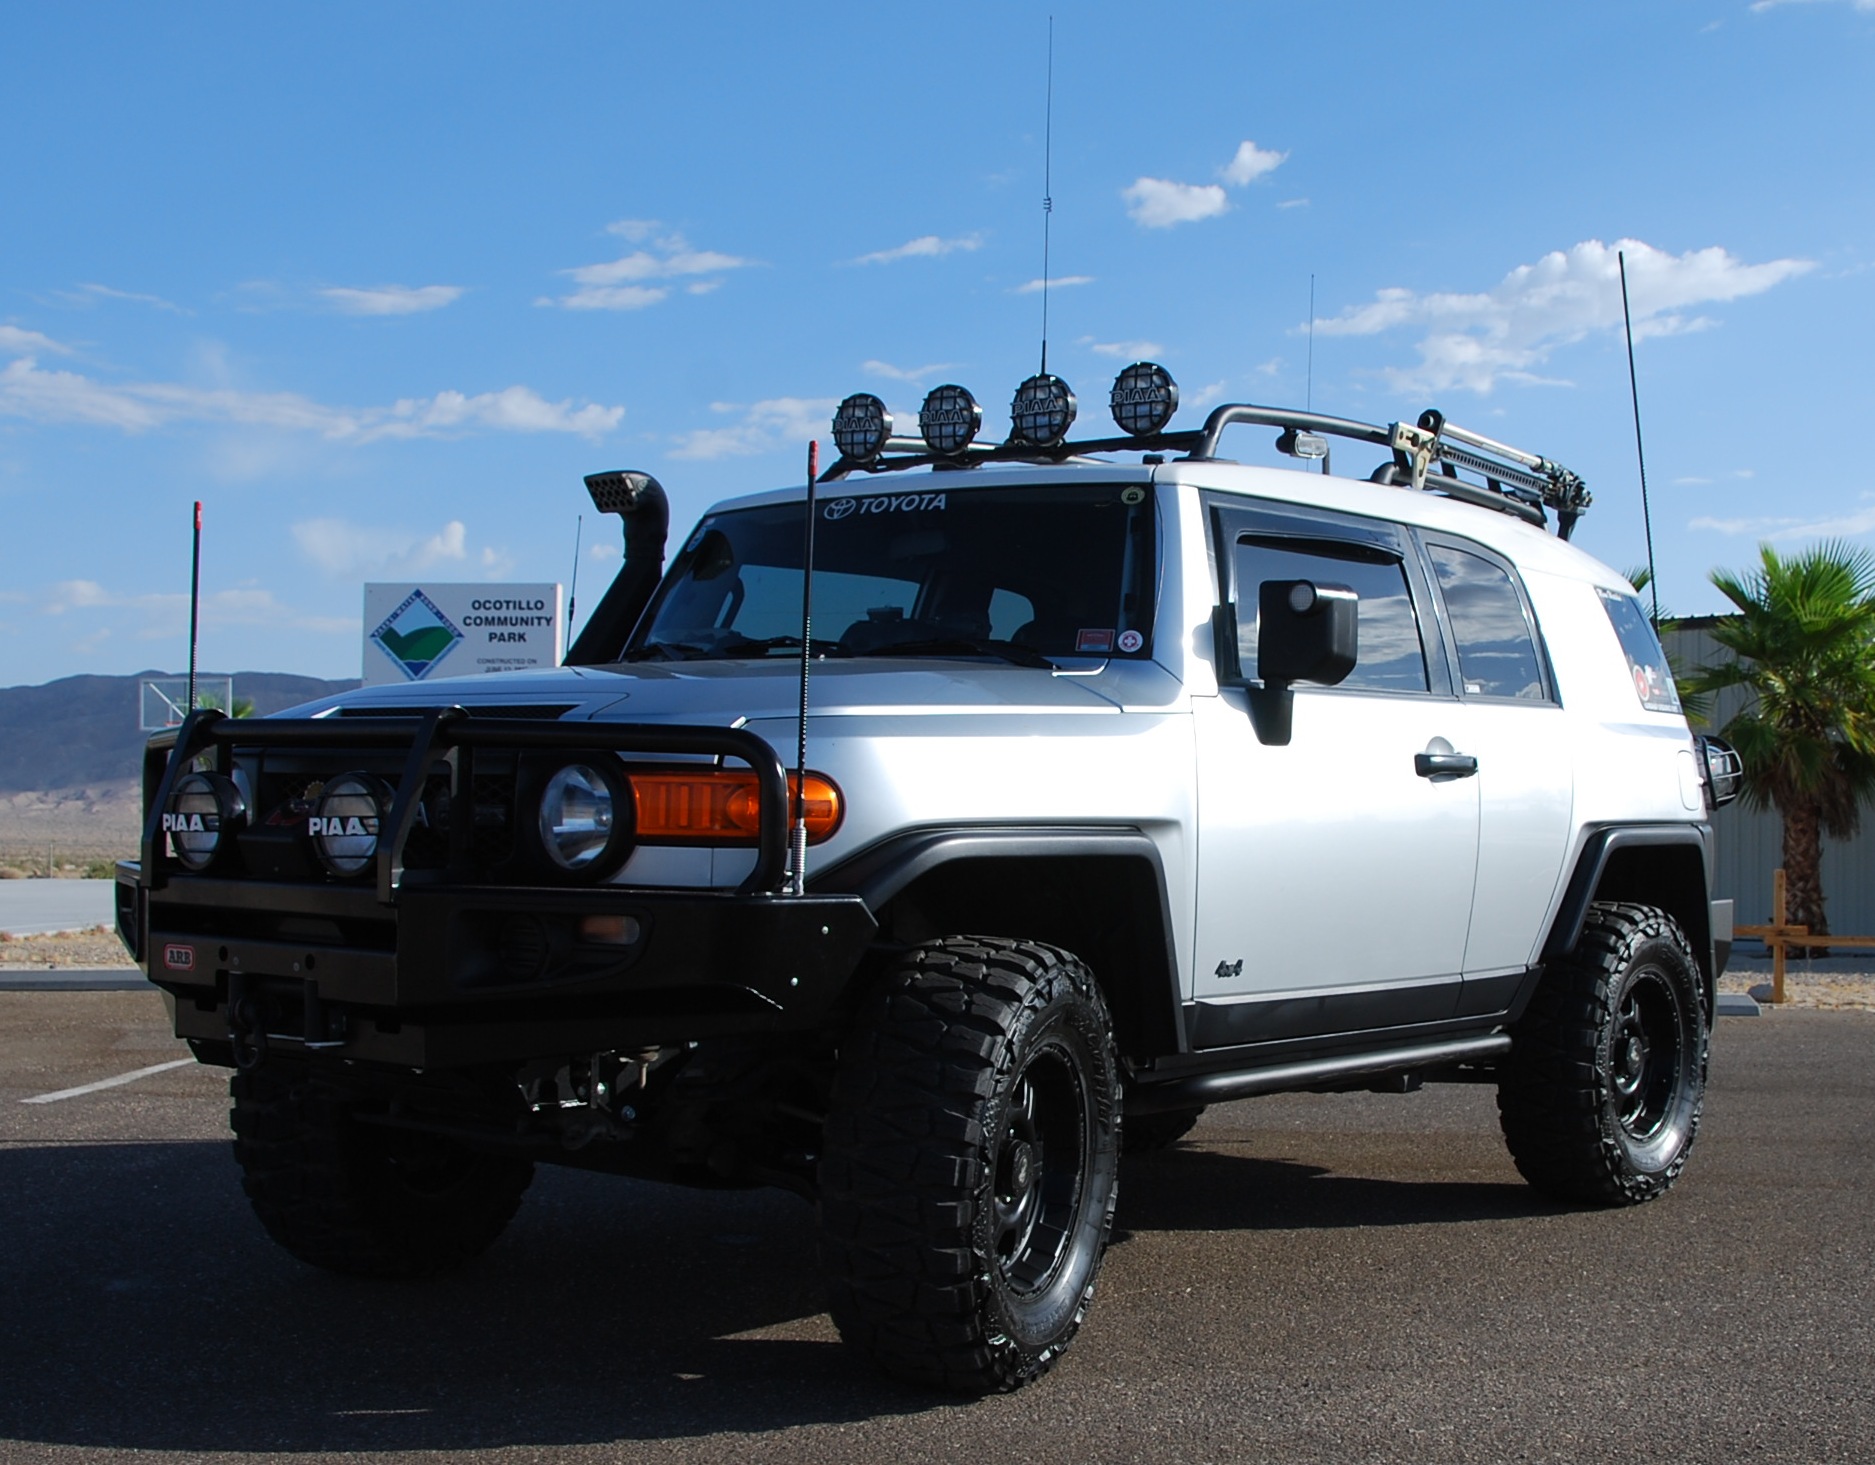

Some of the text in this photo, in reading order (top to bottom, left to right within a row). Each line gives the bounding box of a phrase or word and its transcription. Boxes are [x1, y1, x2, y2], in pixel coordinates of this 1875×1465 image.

[1110, 387, 1162, 406] PIAA
[1011, 397, 1060, 415] PIAA
[832, 417, 876, 432] PIAA
[919, 409, 964, 425] PIAA
[859, 493, 947, 514] TOYOTA
[471, 599, 545, 611] OCOTILLO
[463, 615, 553, 627] COMMUNITY
[488, 632, 527, 643] PARK
[476, 657, 537, 665] CONSTRUCTED ON
[162, 813, 205, 832] PIAA
[309, 816, 368, 836] PIAA
[168, 949, 191, 965] ARB
